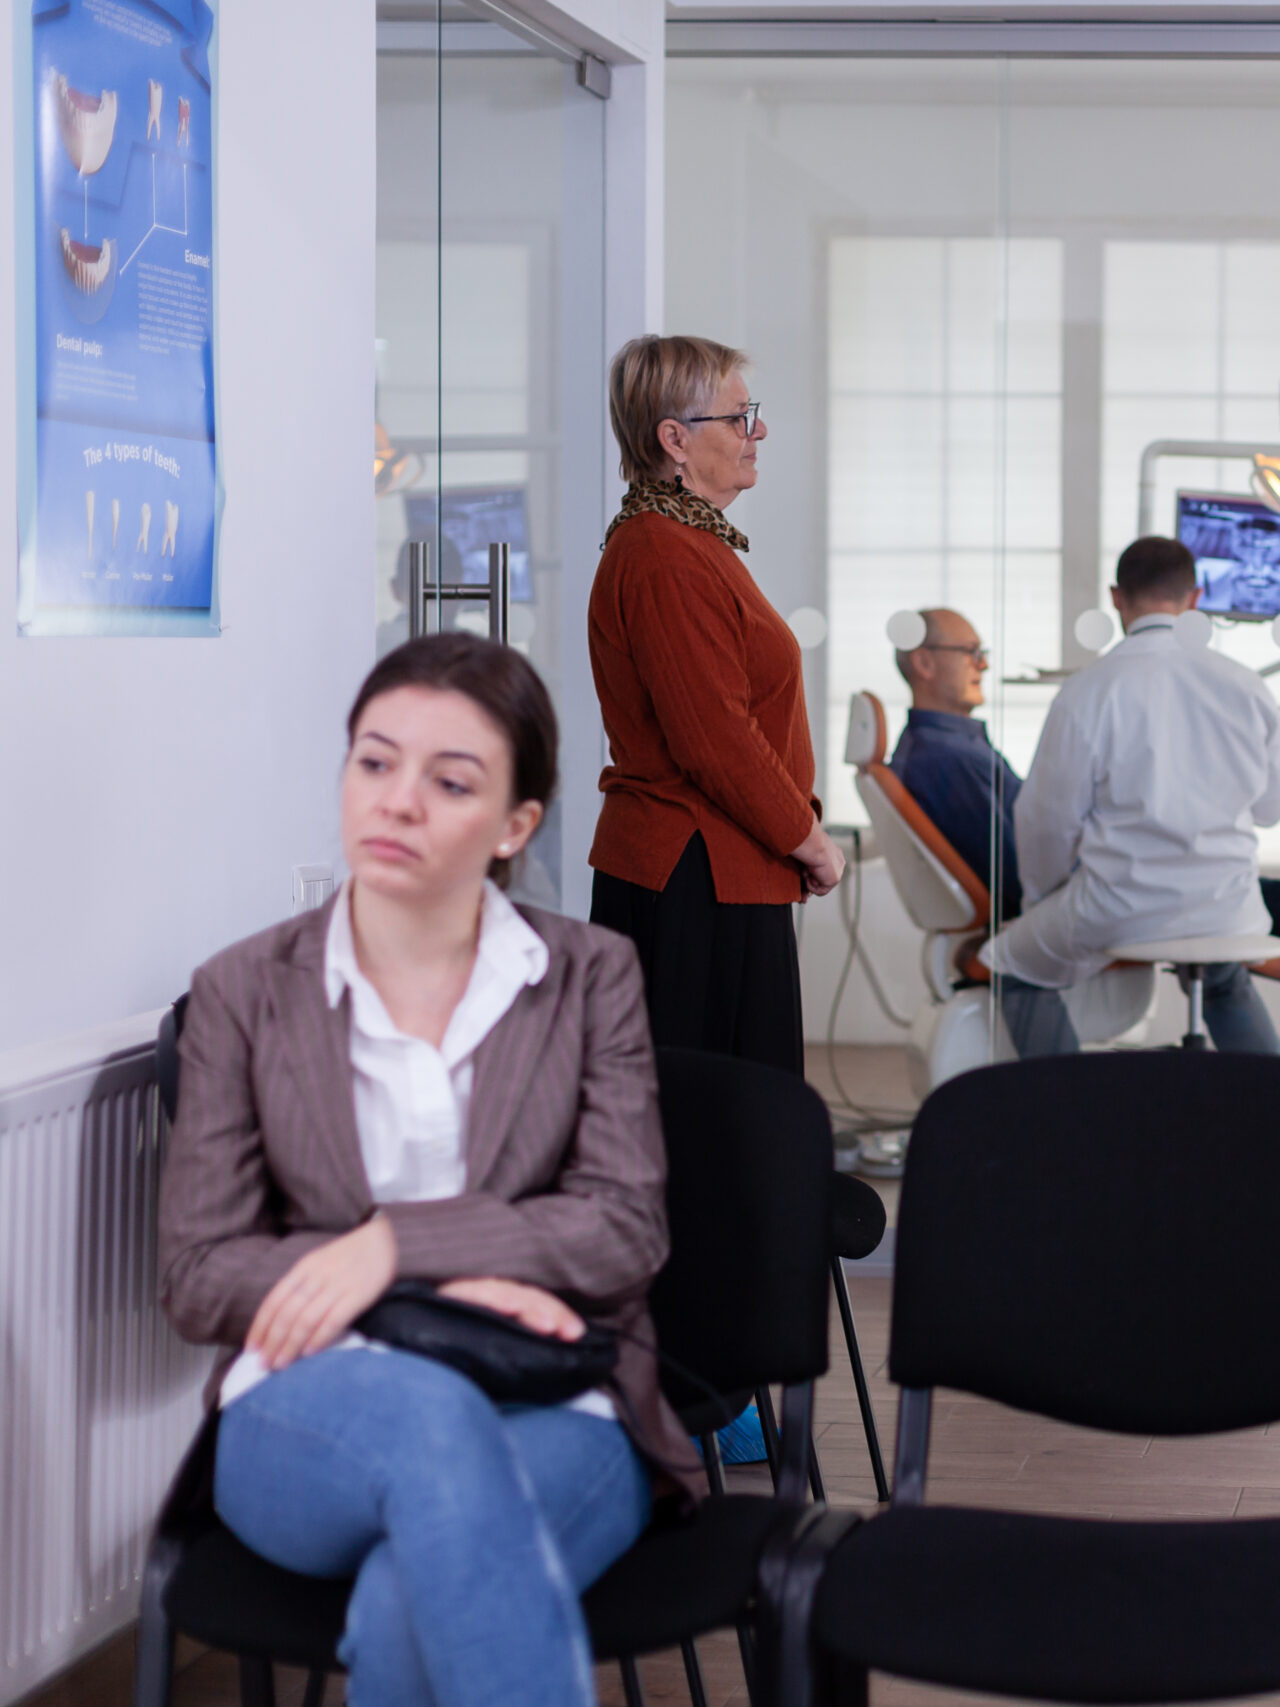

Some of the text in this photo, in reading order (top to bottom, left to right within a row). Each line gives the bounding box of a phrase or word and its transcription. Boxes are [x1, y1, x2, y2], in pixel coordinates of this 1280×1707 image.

[56, 333, 82, 352] Dental
[83, 447, 103, 468] The
[105, 442, 112, 460] 4
[113, 442, 140, 462] types
[142, 445, 153, 463] of
